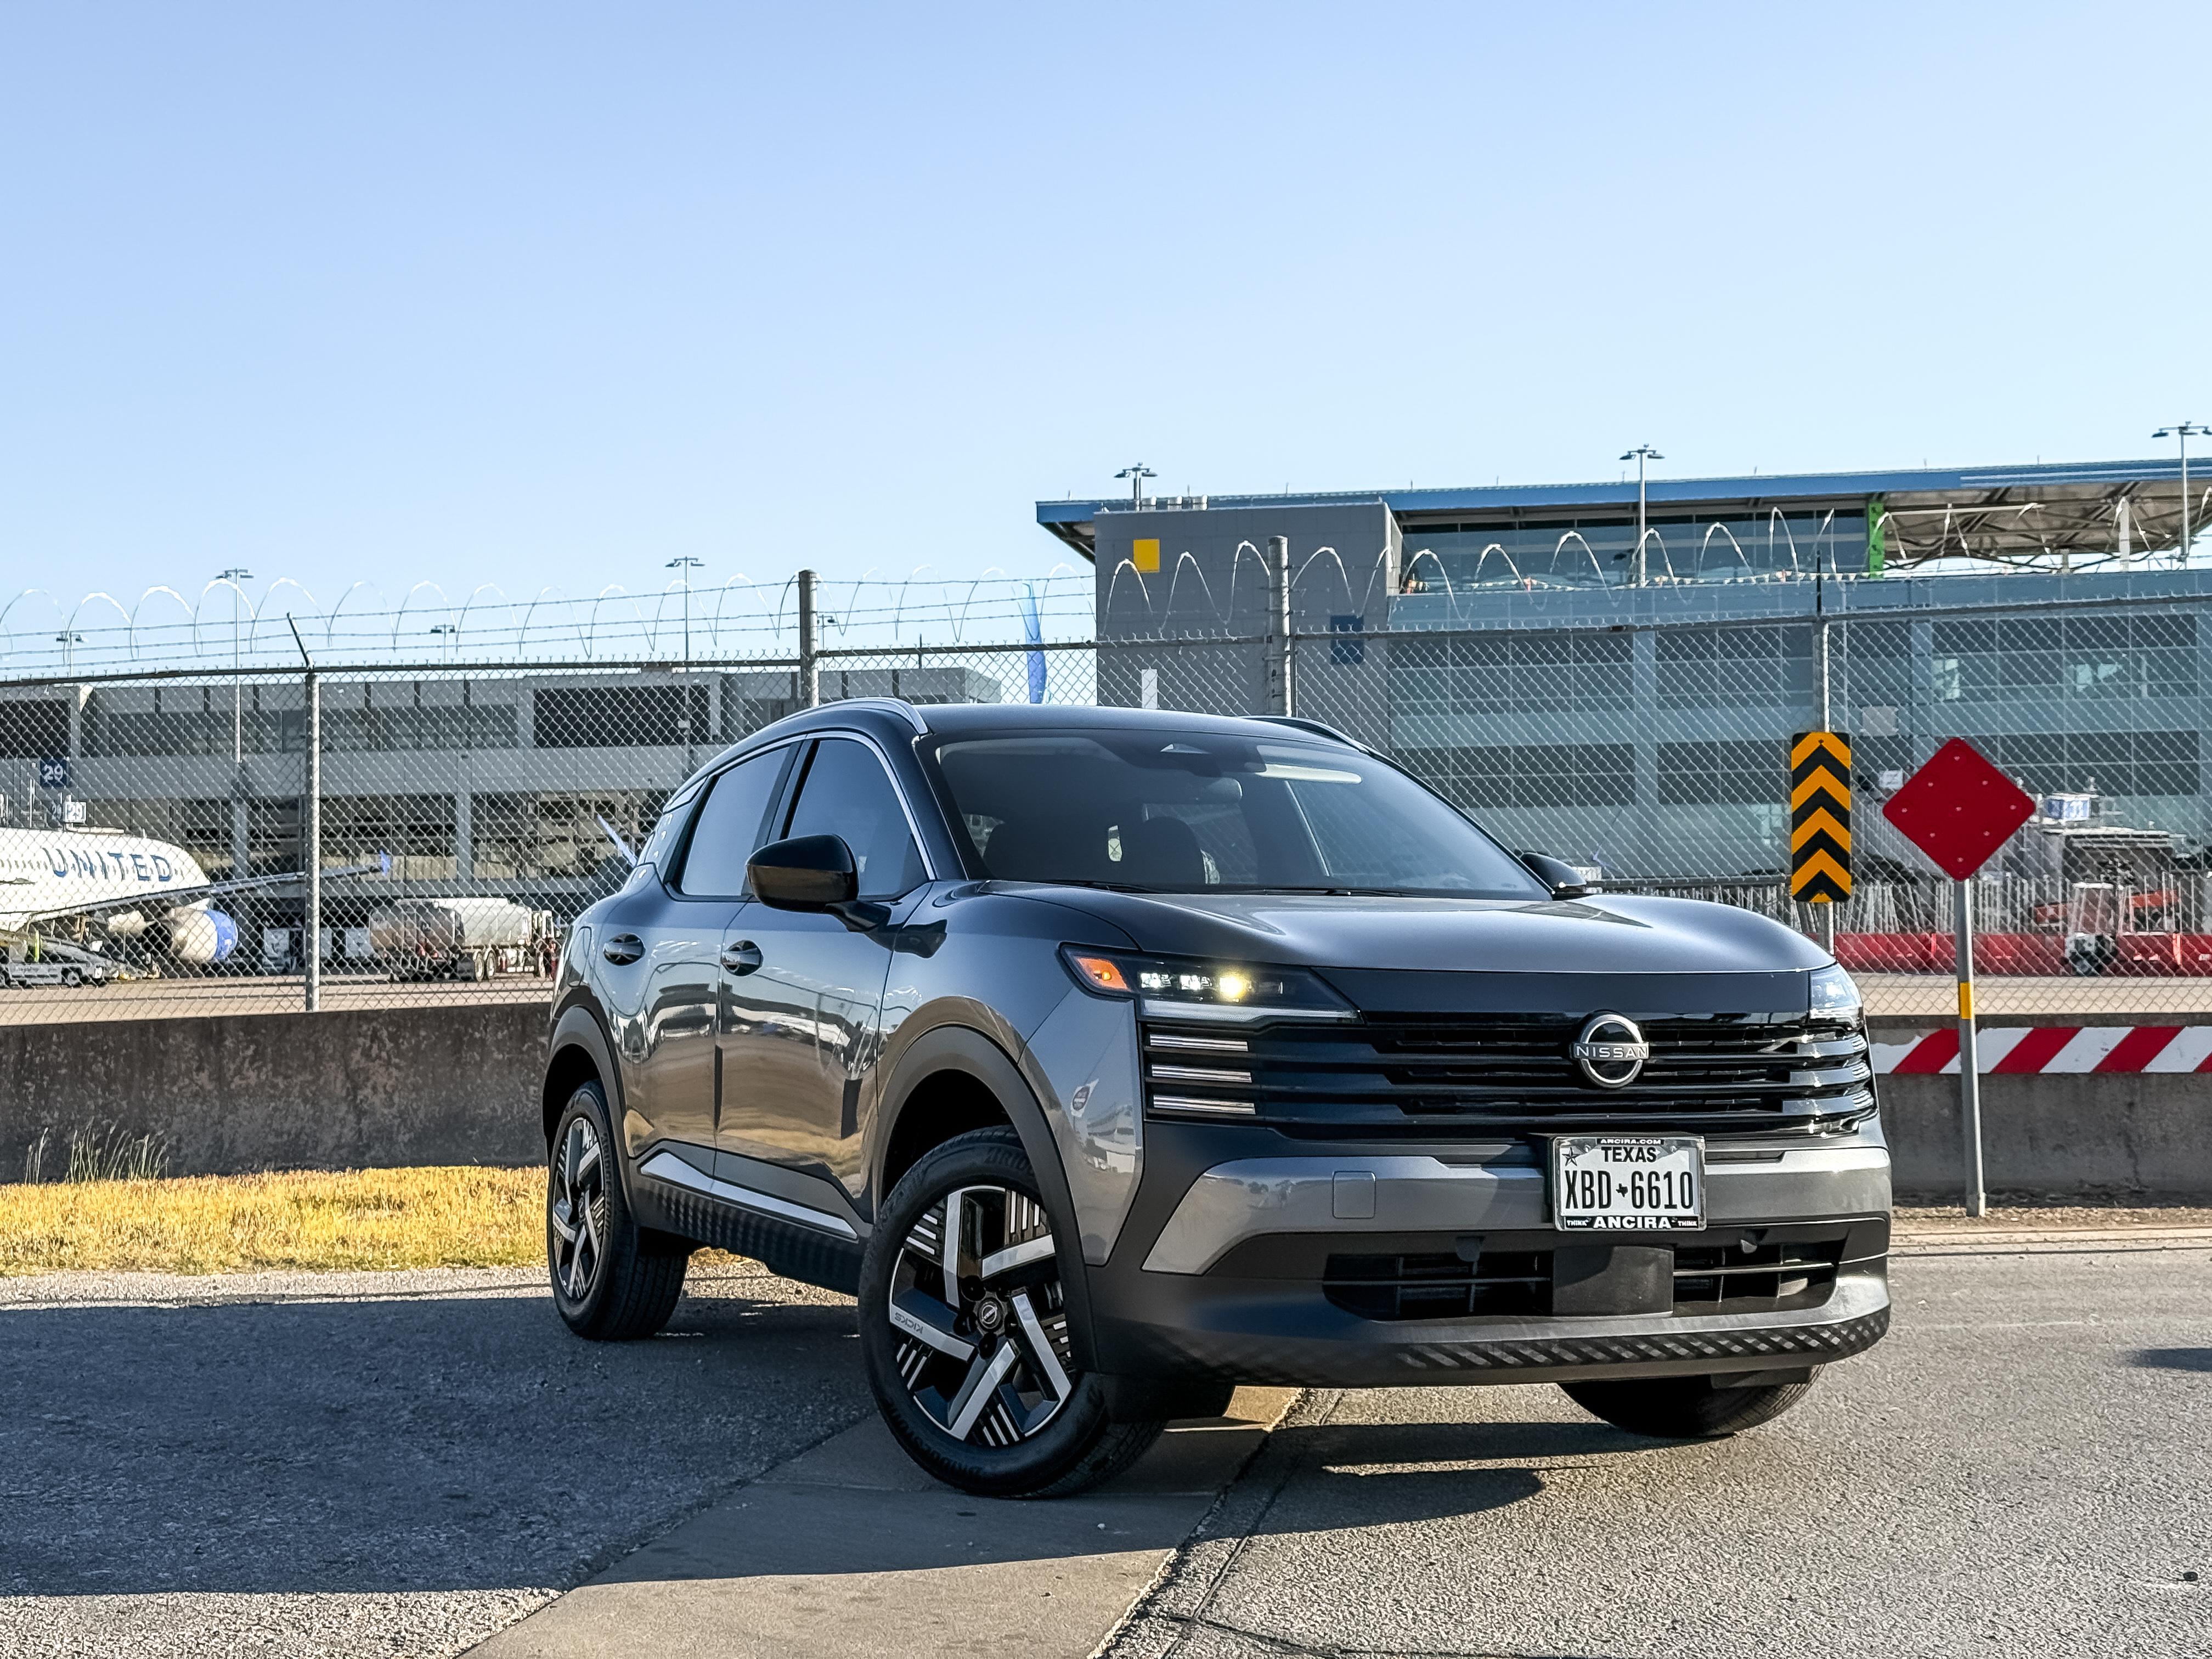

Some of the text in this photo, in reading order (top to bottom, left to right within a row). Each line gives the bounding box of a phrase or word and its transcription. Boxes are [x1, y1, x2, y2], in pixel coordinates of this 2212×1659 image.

[43, 765, 64, 781] 29
[42, 847, 173, 882] UNITED
[1576, 1045, 1647, 1059] NISSAN
[1601, 1146, 1657, 1163] TEXAS
[1565, 1170, 1694, 1209] XBD 6610
[1593, 1216, 1672, 1229] ANCIRA
[894, 1312, 924, 1334] KICKS
